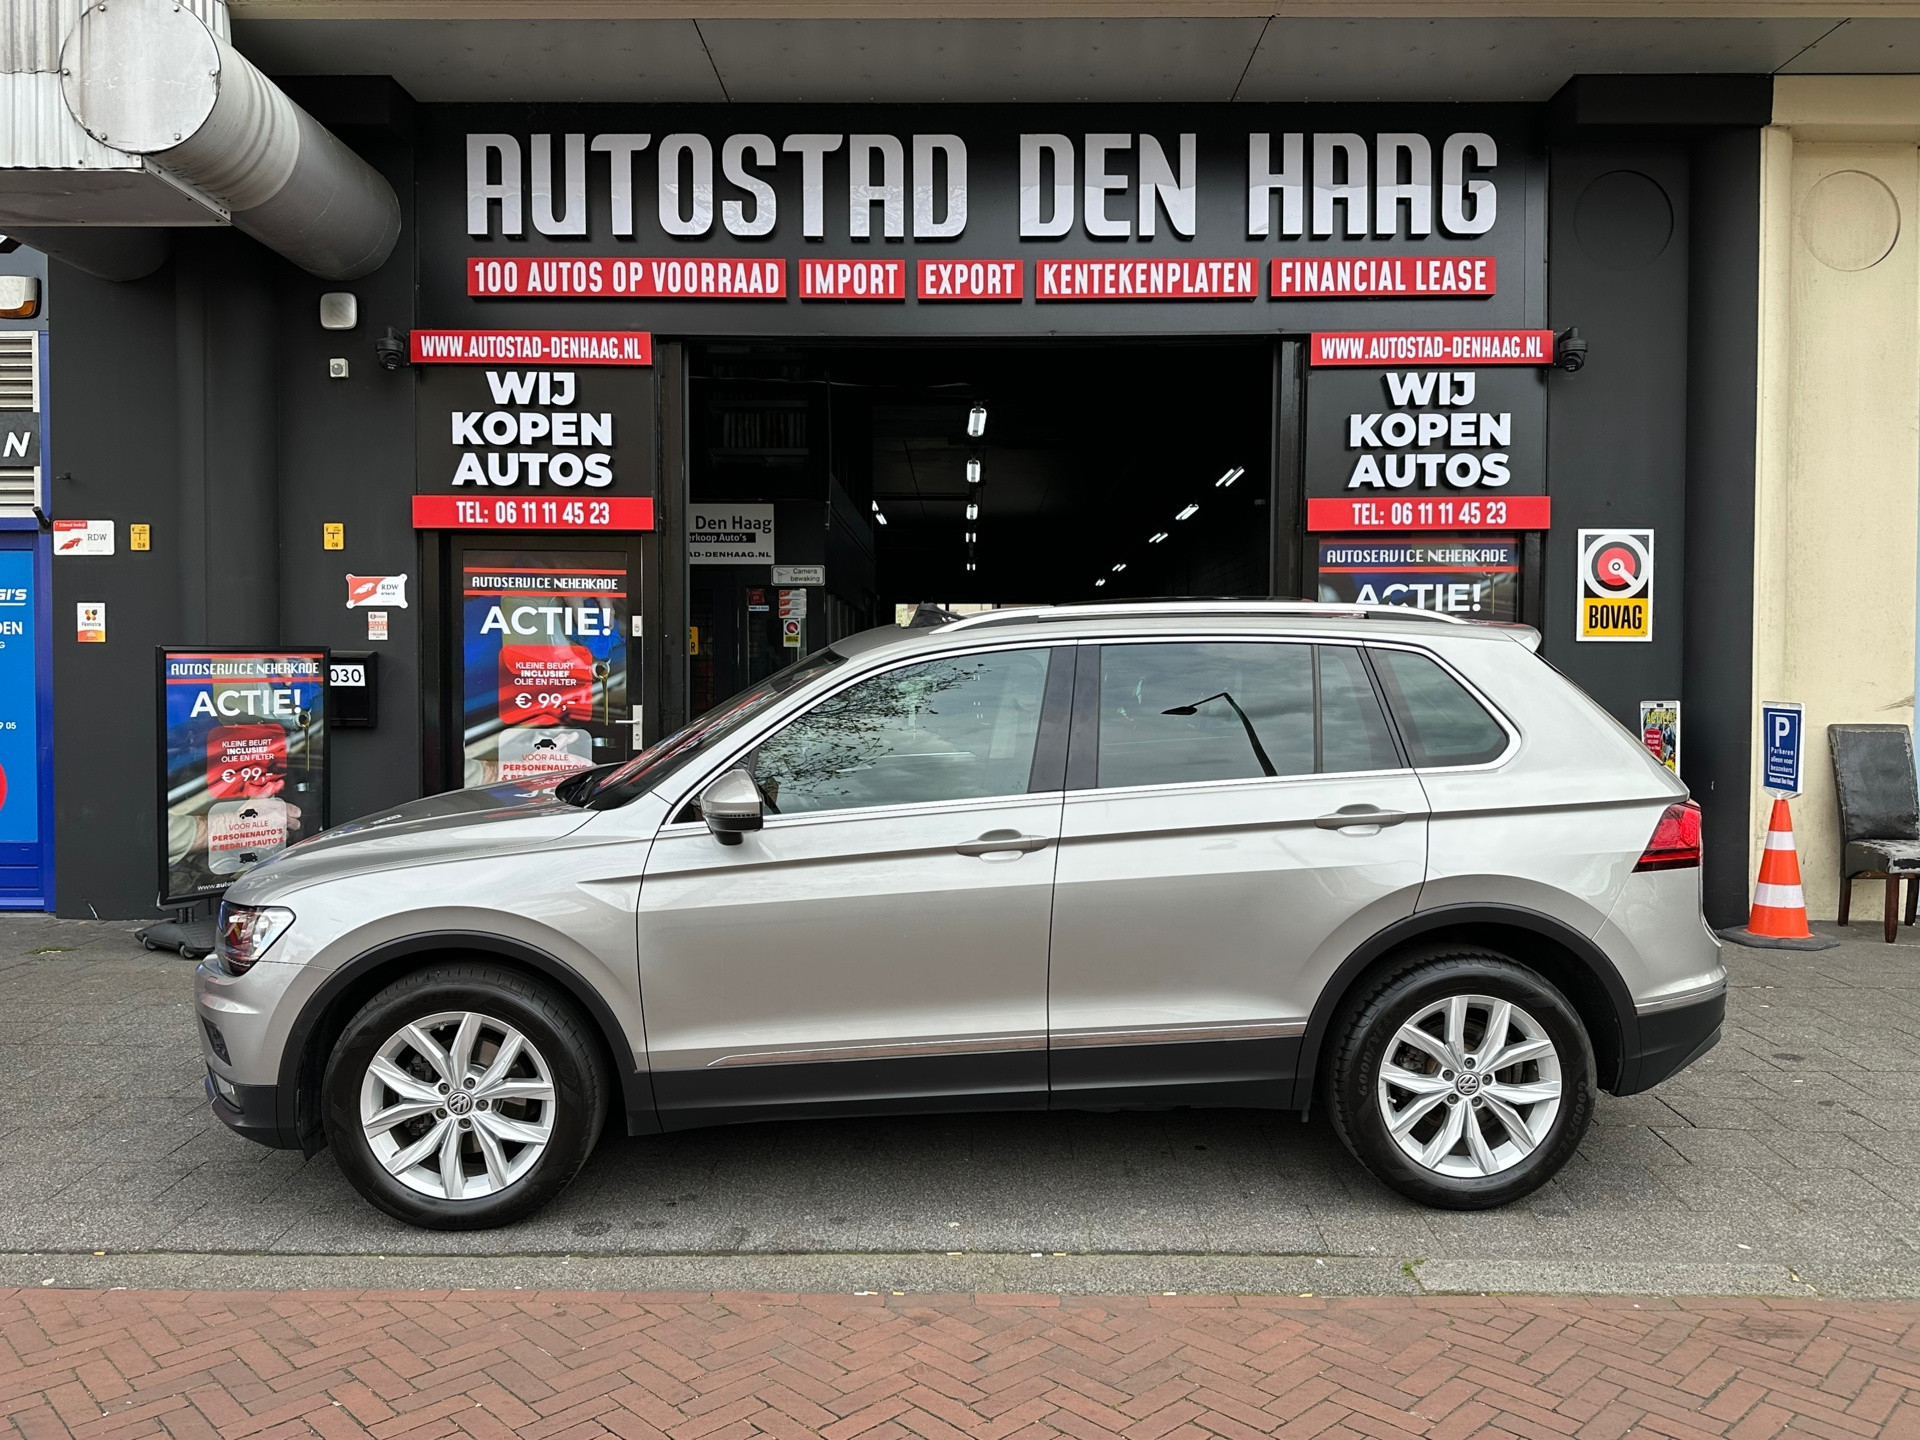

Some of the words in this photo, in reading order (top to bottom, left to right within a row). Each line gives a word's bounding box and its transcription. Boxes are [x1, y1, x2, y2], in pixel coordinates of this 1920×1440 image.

[466, 133, 968, 237] AUTOSTAD
[1019, 132, 1197, 237] DEN
[1248, 132, 1498, 235] HAAG
[474, 260, 518, 292] 100
[527, 261, 603, 292] AUTOS
[612, 261, 644, 293] OP
[651, 261, 780, 294] VOORRAAD
[805, 262, 898, 295] IMPORT
[925, 262, 1016, 295] EXPORT
[1043, 261, 1252, 295] KENTEKENPLATEN
[1280, 259, 1407, 293] FINANCIAL
[1415, 259, 1487, 292] LEASE
[420, 334, 642, 360] WWW.AUTOSTAD-DENHAAG.NL
[1320, 335, 1544, 360] WWW.AUTOSTAD-DENHAAG.NL
[485, 371, 576, 406] WIJ
[1385, 371, 1477, 407] WIJ
[451, 411, 613, 446] KOPEN
[1349, 412, 1512, 448] KOPEN
[451, 452, 613, 487] AUTOS
[1347, 452, 1511, 489] AUTOS
[456, 501, 489, 523] TEL:
[495, 502, 517, 523] 06
[521, 502, 537, 523] 11
[542, 502, 557, 523] 11
[562, 502, 584, 523] 45
[589, 502, 610, 524] 23
[1352, 503, 1385, 525] TEL:
[1390, 503, 1413, 525] 06
[1417, 503, 1434, 525] 11
[1437, 502, 1454, 524] 11
[1458, 502, 1481, 524] 45
[1485, 502, 1507, 524] 23
[695, 515, 727, 530] Den
[732, 515, 772, 533] Haag
[87, 533, 108, 541] RDW
[719, 533, 747, 542] Auto's
[1326, 549, 1424, 563] AUTOSERVICE
[1427, 549, 1508, 563] NEHERKADE
[472, 576, 551, 589] AUTOSERVICE
[553, 578, 619, 590] NEHERKADE
[790, 575, 820, 583] bewaking
[1355, 583, 1481, 612] ACTIE!
[480, 606, 612, 636] ACTIE!
[1588, 604, 1643, 631] BOVAG
[171, 663, 253, 676] AUTOSERVICE
[256, 662, 319, 675] NEHERKADE
[515, 661, 544, 669] KLEINE
[547, 661, 575, 670] BEURT
[520, 669, 570, 678] INCLUSIEF
[514, 678, 534, 686] OLIE
[536, 678, 548, 686] EN
[549, 678, 577, 686] FILTER
[190, 688, 302, 718] ACTIE!
[515, 693, 532, 709] €
[537, 693, 576, 711] 99,-
[5, 722, 17, 730] 05
[1775, 716, 1790, 747] P
[222, 740, 248, 748] KLEINE
[249, 739, 273, 747] BEURT
[226, 747, 269, 755] INCLUSIEF
[1770, 746, 1794, 756] Parkeren
[221, 755, 239, 763] OLIE
[240, 754, 250, 762] EN
[251, 753, 275, 761] FILTER
[521, 753, 547, 761] VOOR
[549, 753, 569, 761] ALLE
[221, 768, 236, 784] €
[212, 828, 283, 842] PERSONENAUTO'S
[228, 822, 251, 831] VOOR
[219, 837, 284, 851] BEDRIJFSAUTO'S
